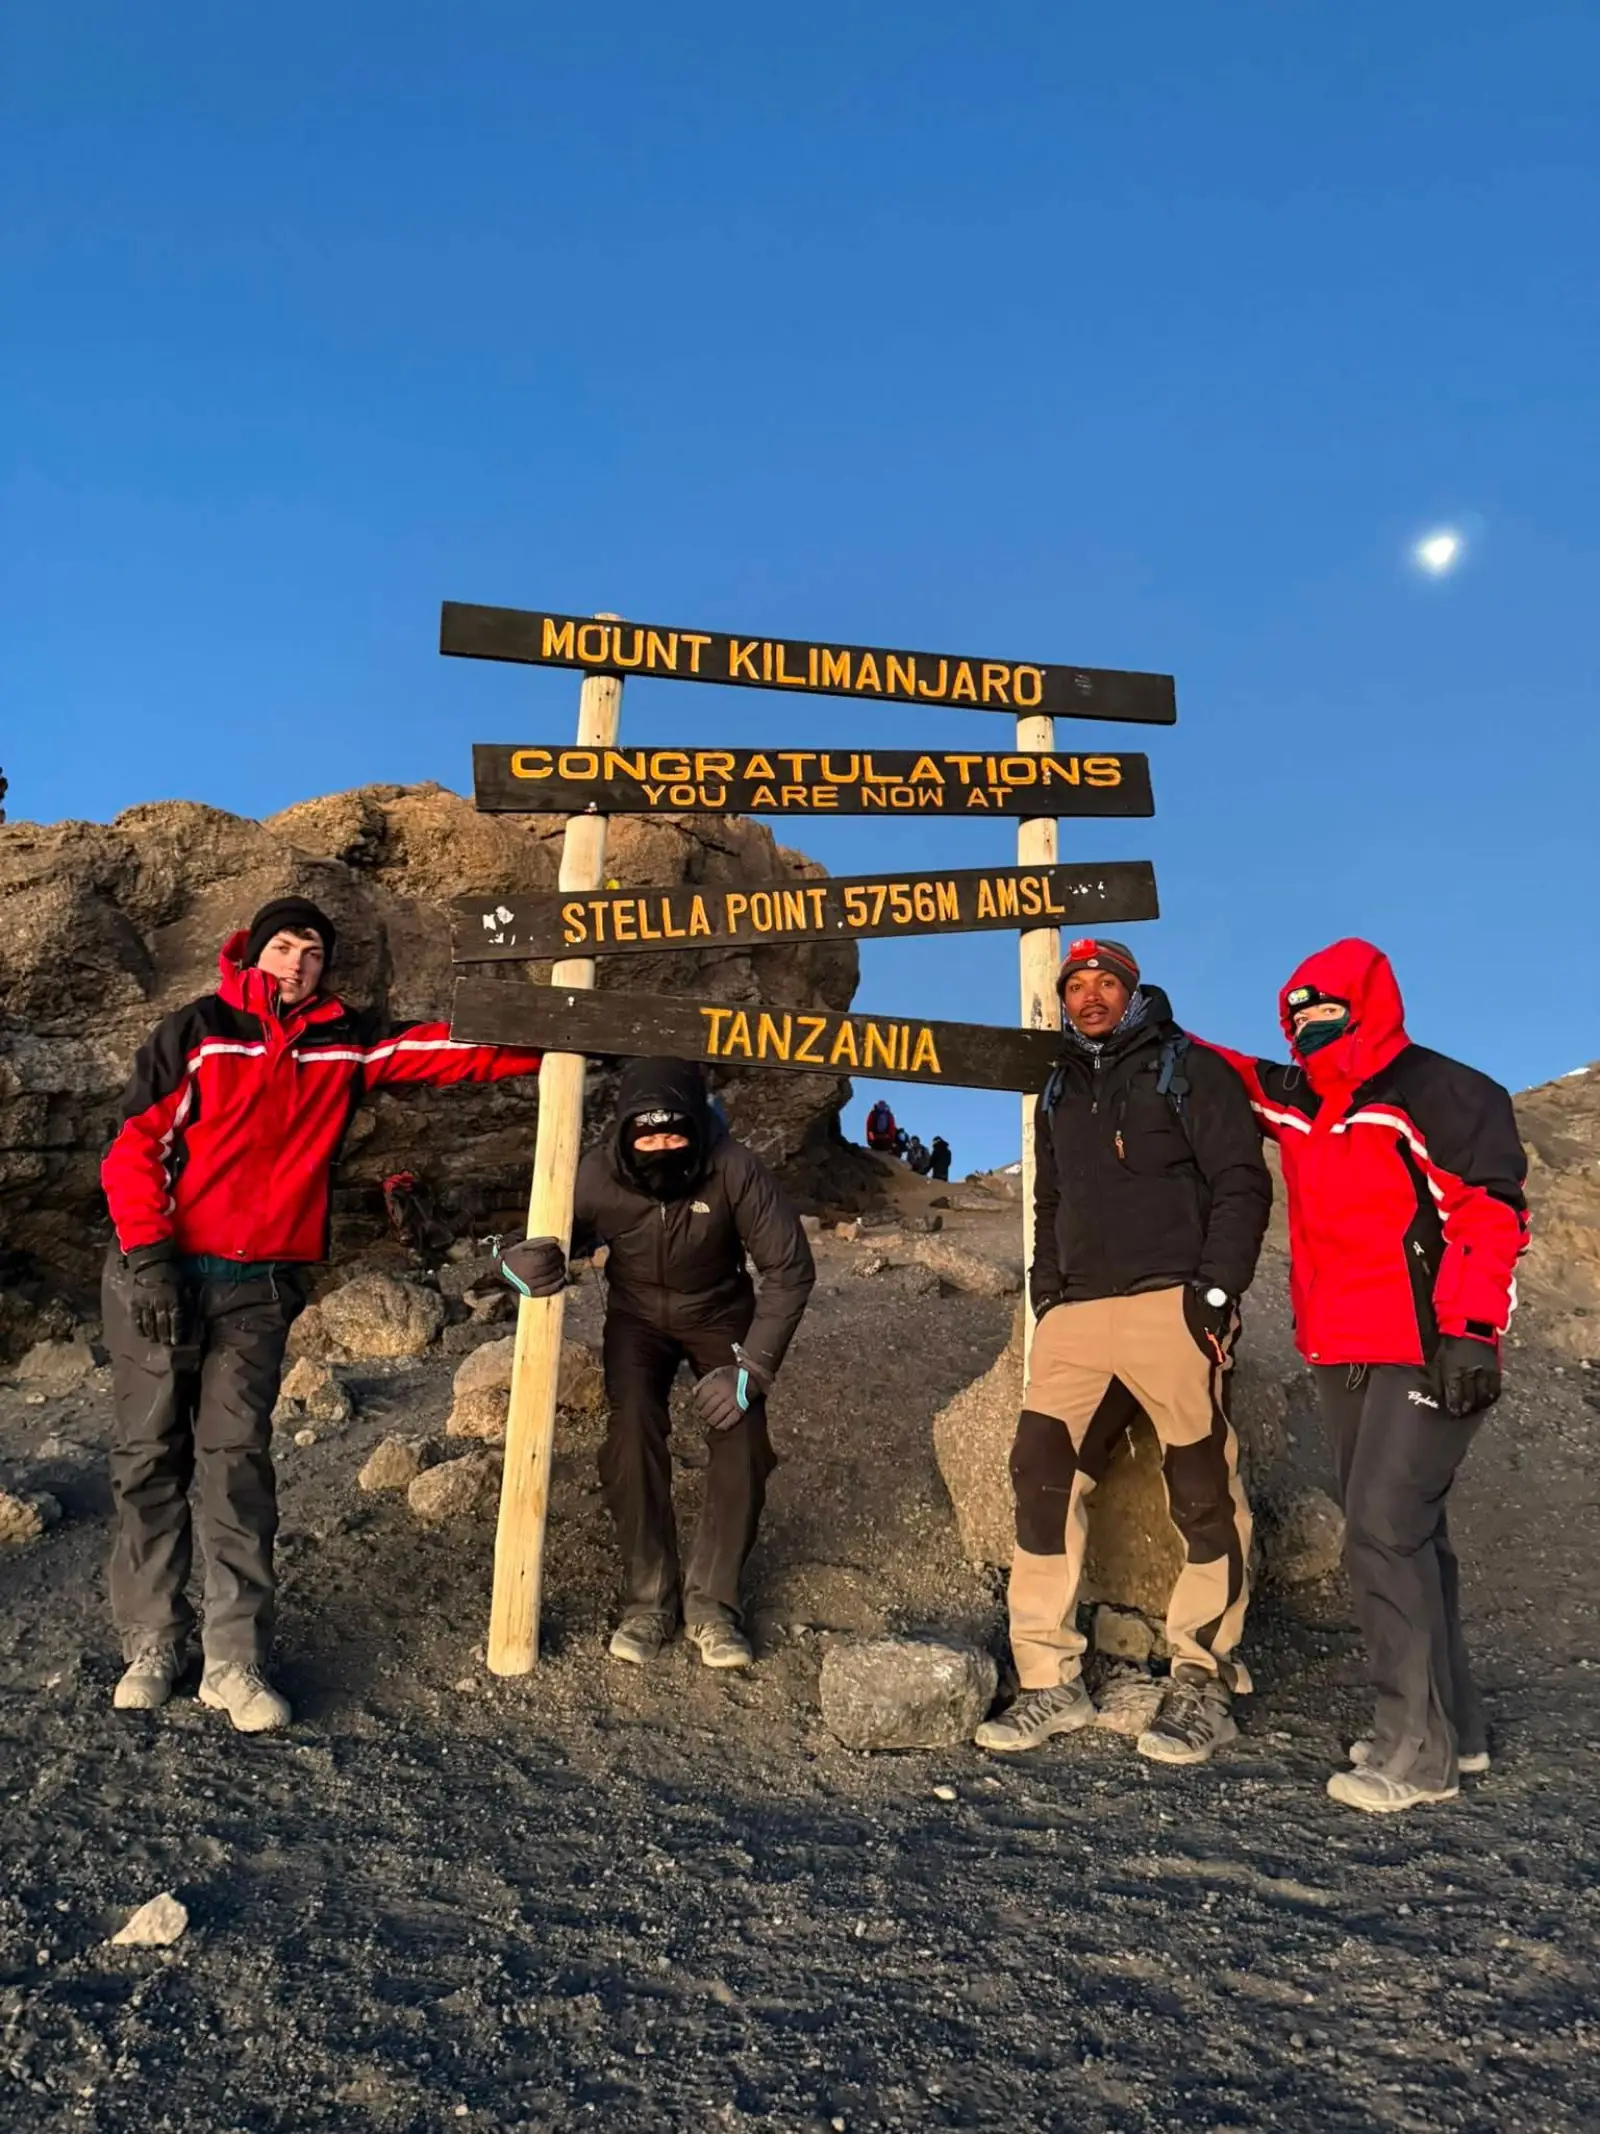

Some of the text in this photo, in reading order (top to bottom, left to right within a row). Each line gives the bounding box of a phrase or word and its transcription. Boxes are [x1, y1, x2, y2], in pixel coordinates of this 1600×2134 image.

[541, 618, 1043, 706] MOUNT KILIMANJARO
[510, 750, 1121, 787] CONGRATULATIONS
[641, 784, 1013, 808] YOU ARE NOW AT
[561, 876, 1066, 944] STELLA POINT 5756M AMSL
[699, 1007, 942, 1074] TANZANIA
